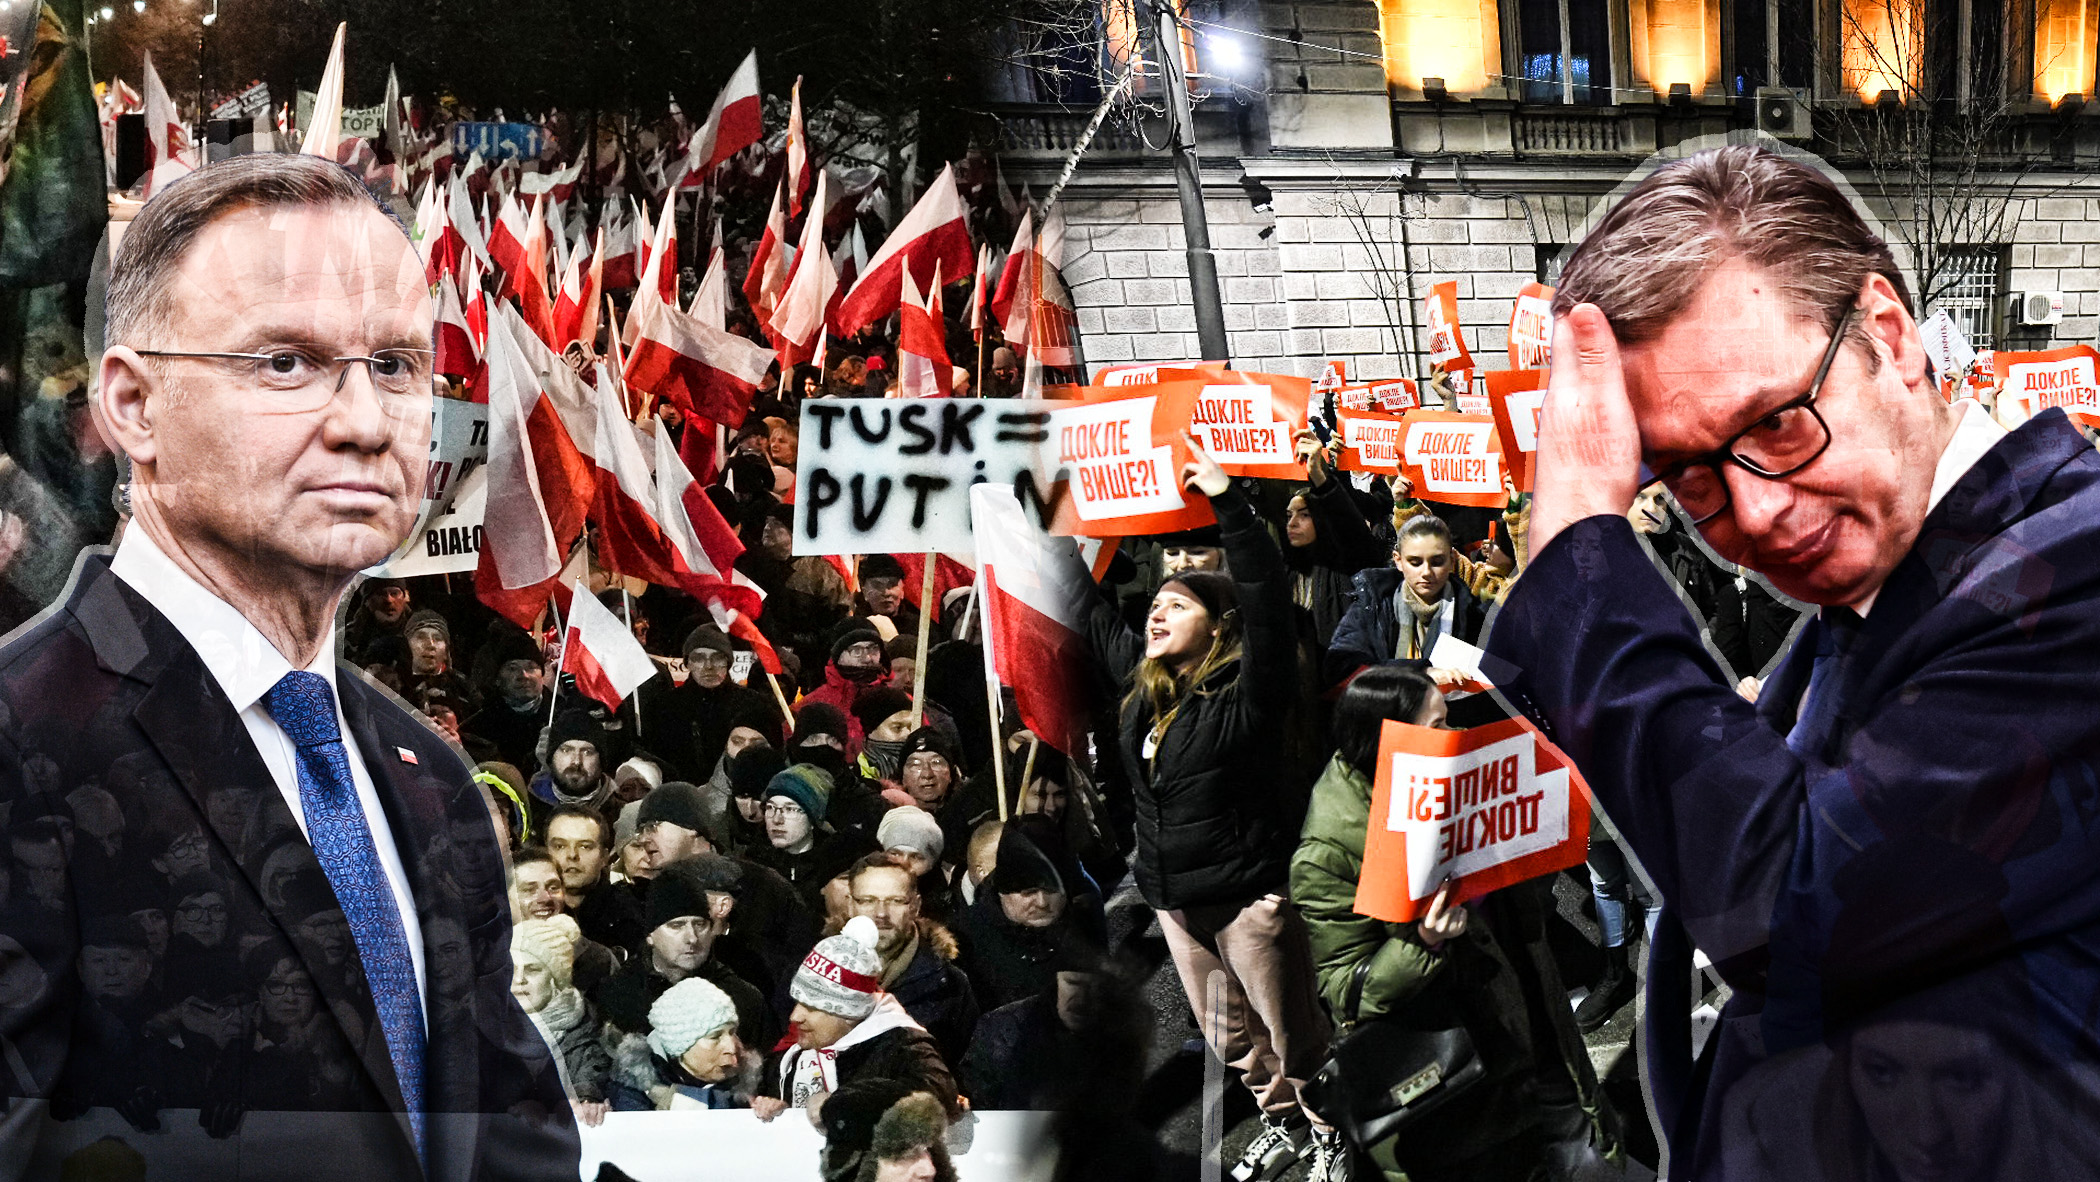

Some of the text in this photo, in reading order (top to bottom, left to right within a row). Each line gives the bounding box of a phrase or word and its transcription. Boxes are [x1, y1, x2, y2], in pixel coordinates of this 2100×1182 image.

[2024, 367, 2081, 391] ДОКЛЕ
[2038, 386, 2097, 411] ВИШЕ?!
[1193, 399, 1254, 425] ДОКЛЕ
[1059, 419, 1131, 465] ДОКЛЕ
[1211, 428, 1278, 454] ВИШЕ?!
[1356, 426, 1398, 443] ДОКЛЕ
[1418, 432, 1475, 455] ДОКЛЕ
[1078, 460, 1161, 502] ВИШЕ?!
[1430, 458, 1487, 482] ВИШЕ?!
[1407, 754, 1519, 822] ВИШЕ?!
[1438, 790, 1544, 865] ДОКЛЕ
